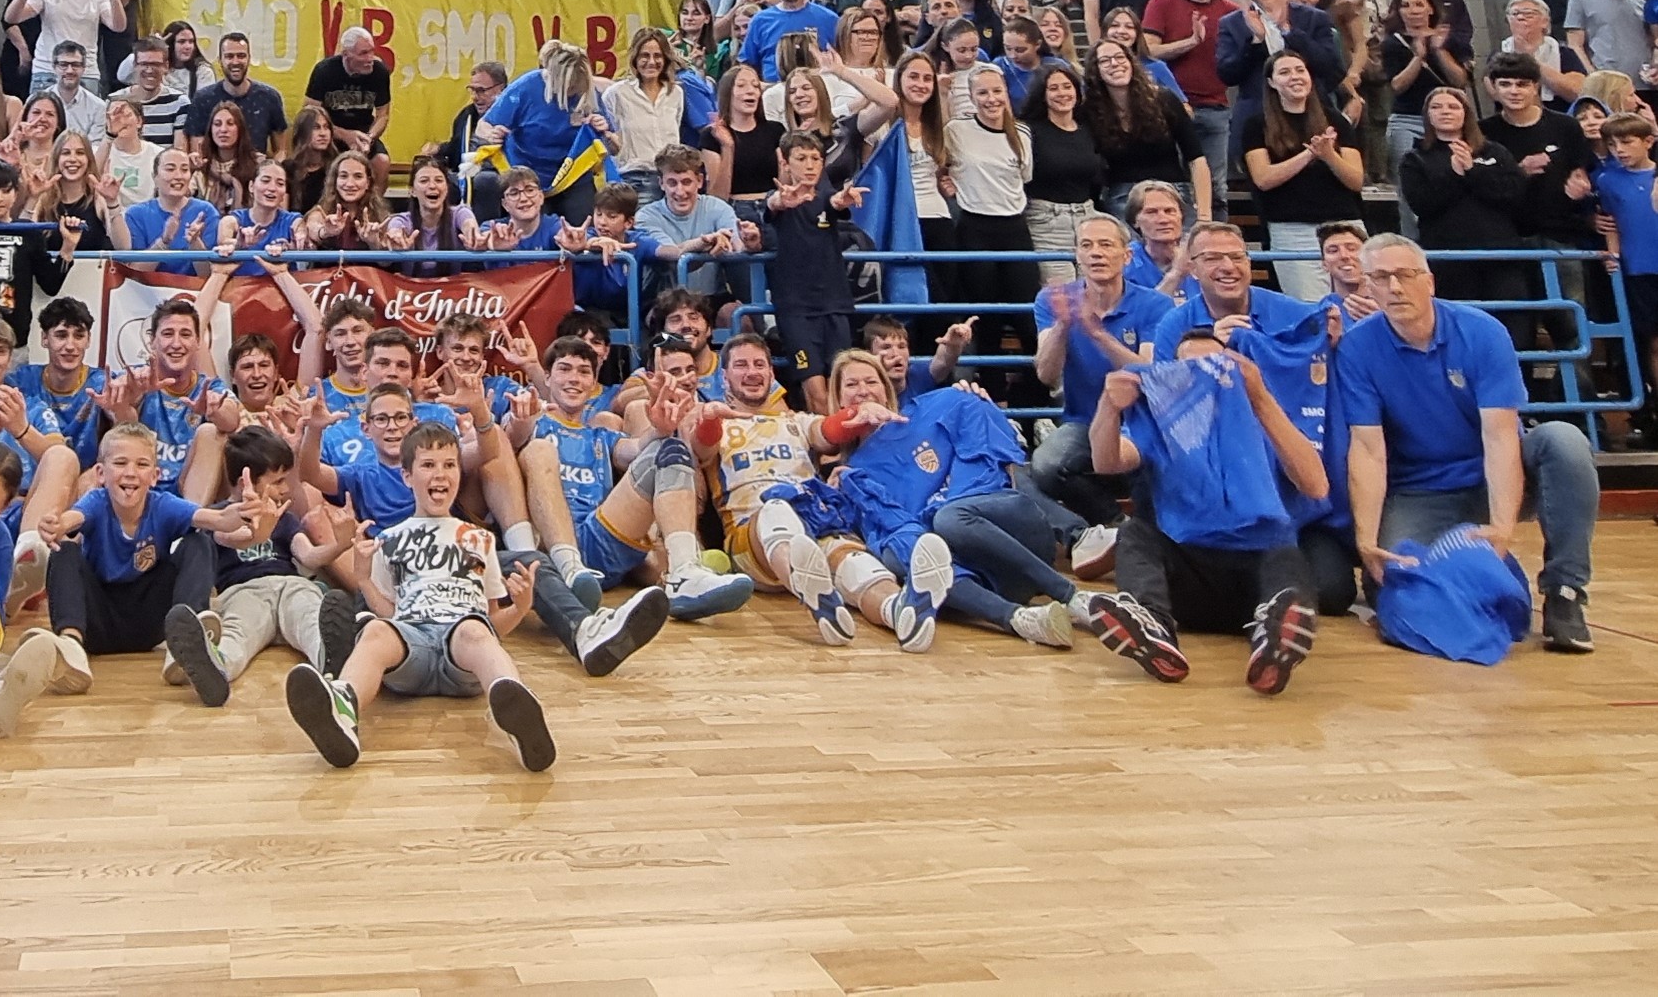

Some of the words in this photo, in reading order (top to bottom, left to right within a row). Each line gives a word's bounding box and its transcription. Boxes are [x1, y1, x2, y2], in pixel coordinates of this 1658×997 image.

[417, 8, 516, 81] SMO
[384, 287, 508, 323] d'India
[342, 439, 363, 463] 9
[726, 426, 747, 449] 8
